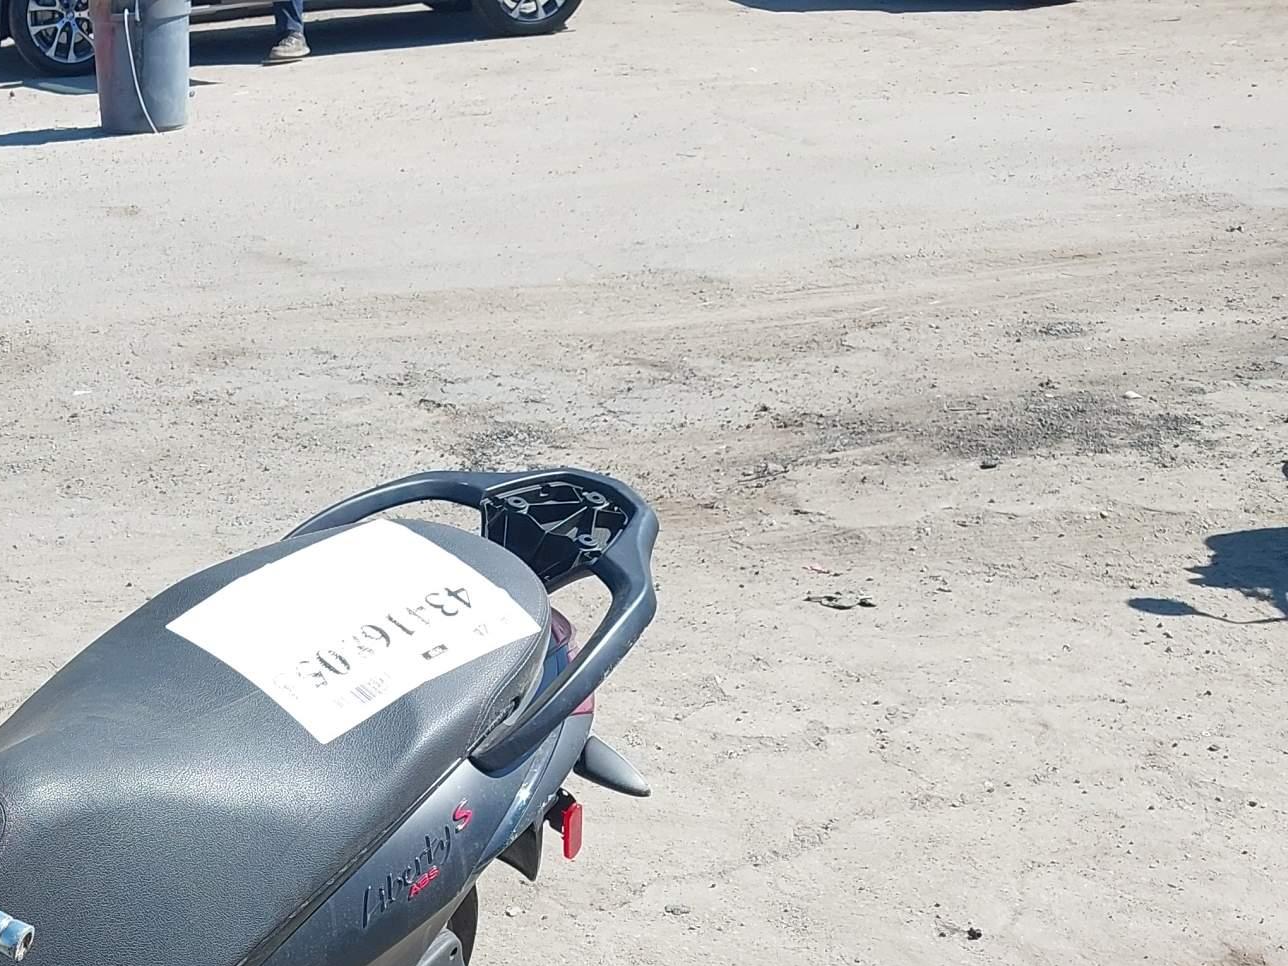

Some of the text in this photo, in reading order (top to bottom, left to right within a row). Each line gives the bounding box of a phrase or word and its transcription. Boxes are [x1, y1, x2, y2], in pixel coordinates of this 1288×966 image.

[362, 798, 473, 929] Liberty S
[408, 865, 440, 901] ABS
